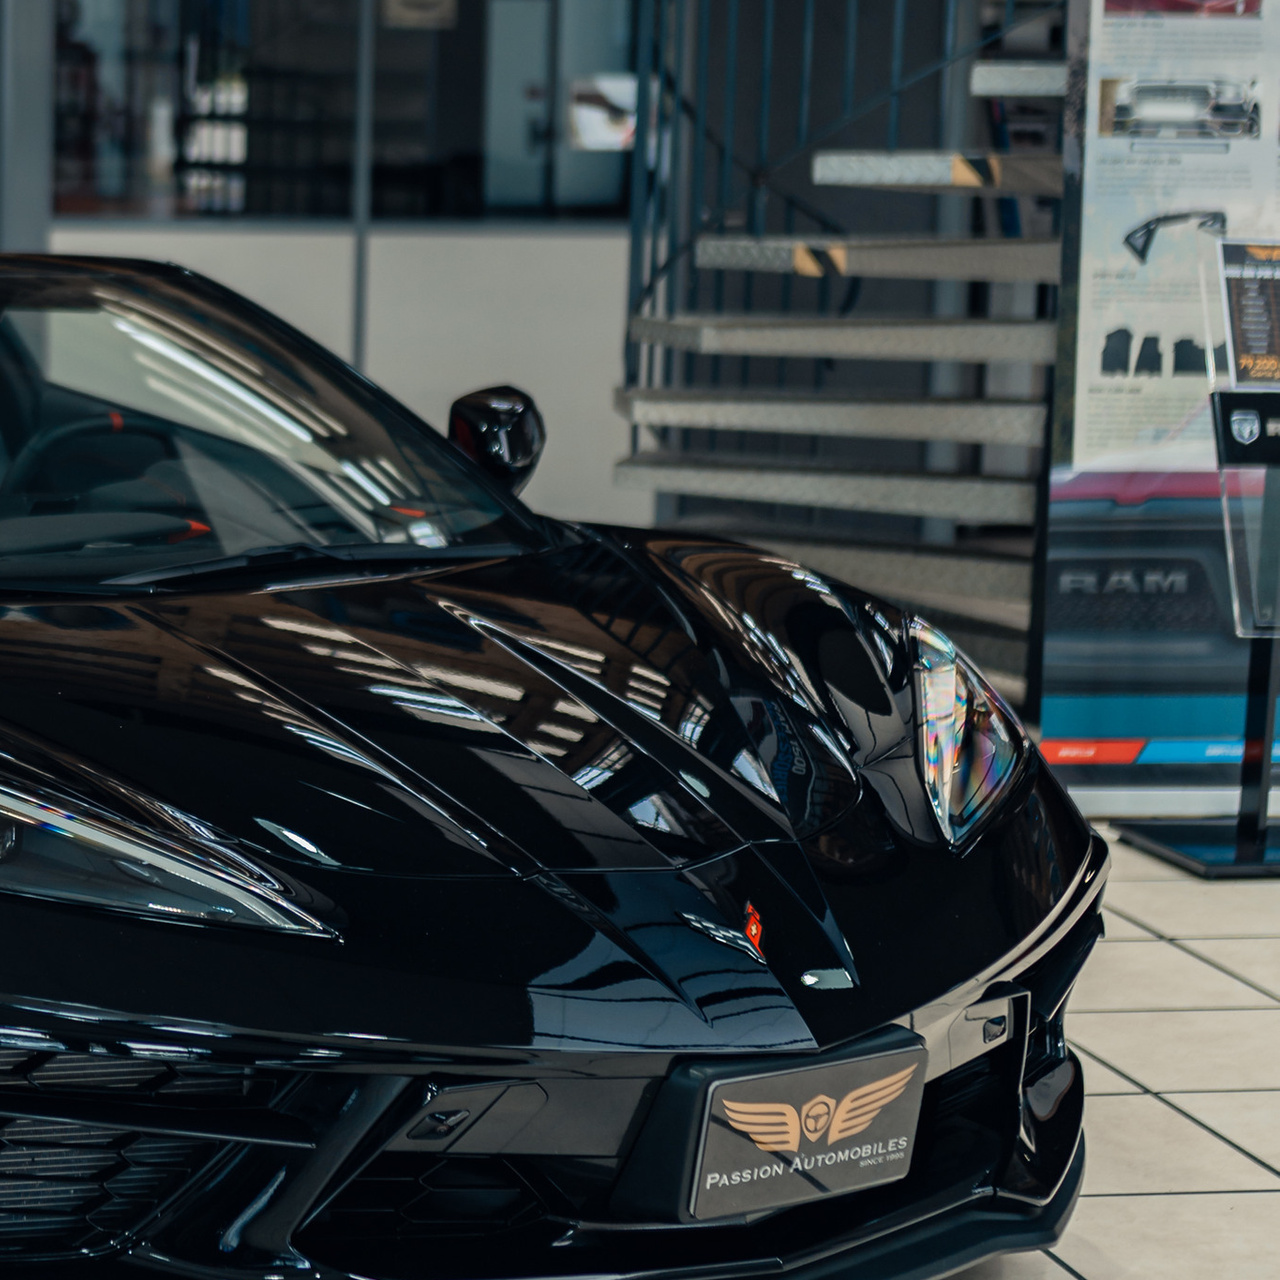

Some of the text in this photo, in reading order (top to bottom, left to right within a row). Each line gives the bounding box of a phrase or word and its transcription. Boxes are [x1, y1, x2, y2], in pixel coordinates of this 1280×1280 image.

[1058, 569, 1188, 595] RAM
[705, 1136, 908, 1190] PASSION AUTOMOBILES
[858, 1156, 885, 1168] SINCE
